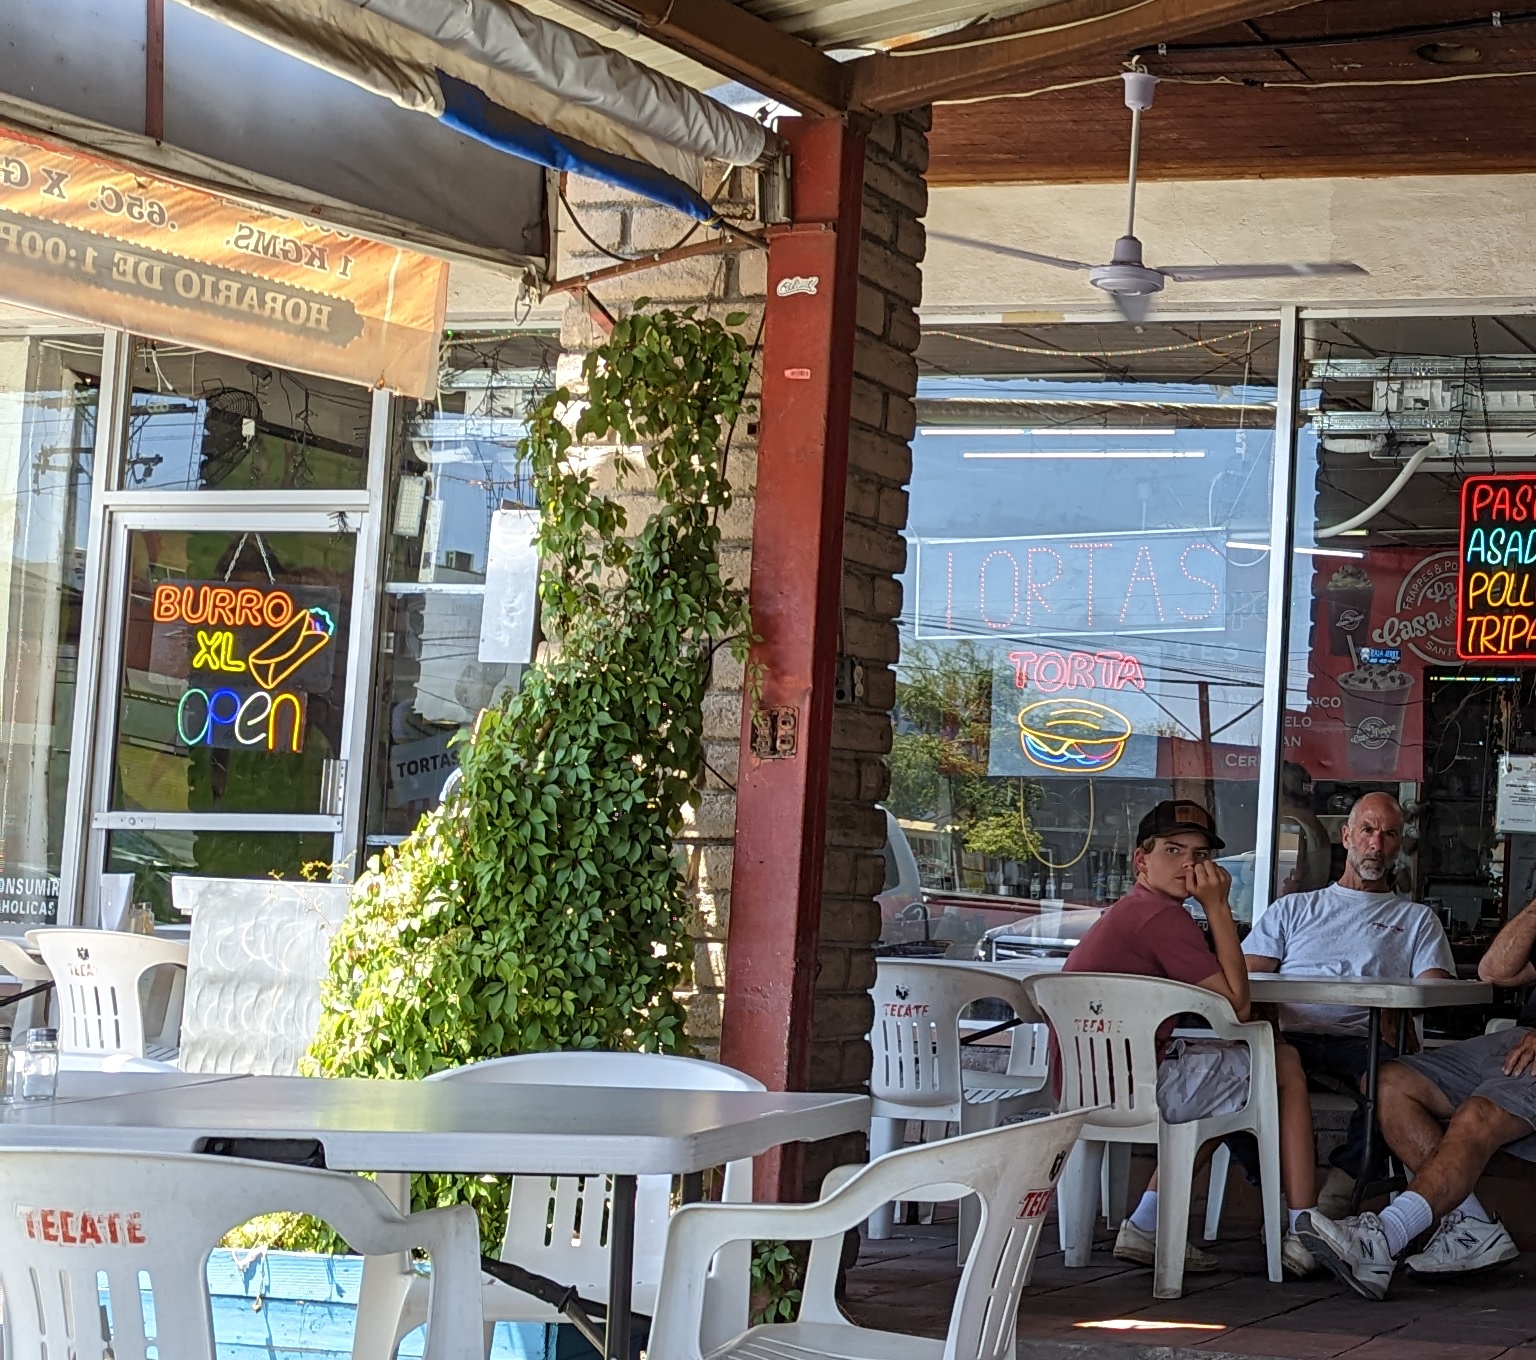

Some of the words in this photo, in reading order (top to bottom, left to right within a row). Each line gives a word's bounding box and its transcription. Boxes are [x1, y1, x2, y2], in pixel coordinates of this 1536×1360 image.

[154, 585, 294, 628] BURRO
[1402, 569, 1434, 610] FRAPPES
[1372, 611, 1443, 647] Casa
[192, 630, 246, 672] XL
[1008, 651, 1146, 693] TORTA
[0, 876, 59, 897] ONSUMIR
[1, 899, 56, 916] HOLICAS
[882, 1003, 930, 1018] TECATE
[1074, 1018, 1123, 1033] TECAT
[23, 1207, 148, 1244] TECATE
